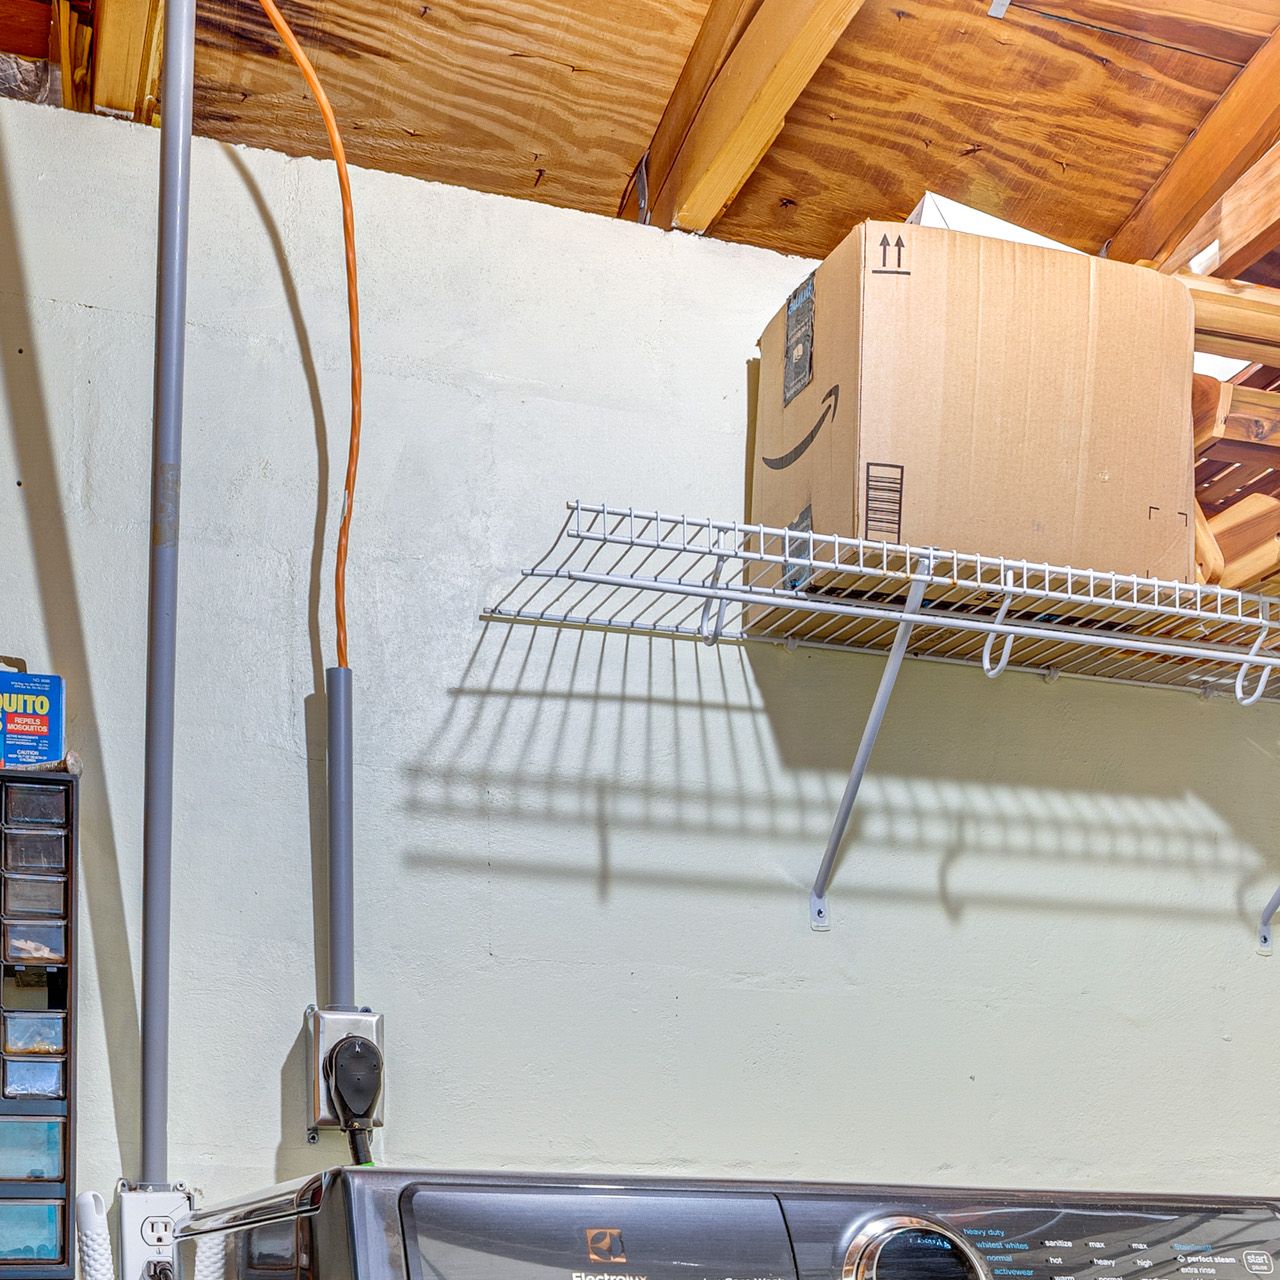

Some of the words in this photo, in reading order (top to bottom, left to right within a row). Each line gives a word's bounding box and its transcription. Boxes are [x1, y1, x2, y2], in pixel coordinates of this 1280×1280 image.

[14, 717, 41, 725] REPELS
[7, 723, 48, 733] MOSQUITOS
[963, 1228, 987, 1238] heavy
[988, 1228, 1005, 1238] duty
[976, 1241, 1004, 1250] whitest
[1006, 1242, 1029, 1250] whites
[1045, 1239, 1073, 1248] sanitize
[986, 1254, 1013, 1262] normal
[1049, 1257, 1063, 1265] hot
[1094, 1258, 1116, 1267] heavy
[1187, 1255, 1213, 1264] perfect
[1214, 1256, 1236, 1264] steam
[1247, 1254, 1269, 1264] start
[1136, 1259, 1153, 1268] high
[994, 1268, 1034, 1276] activewear
